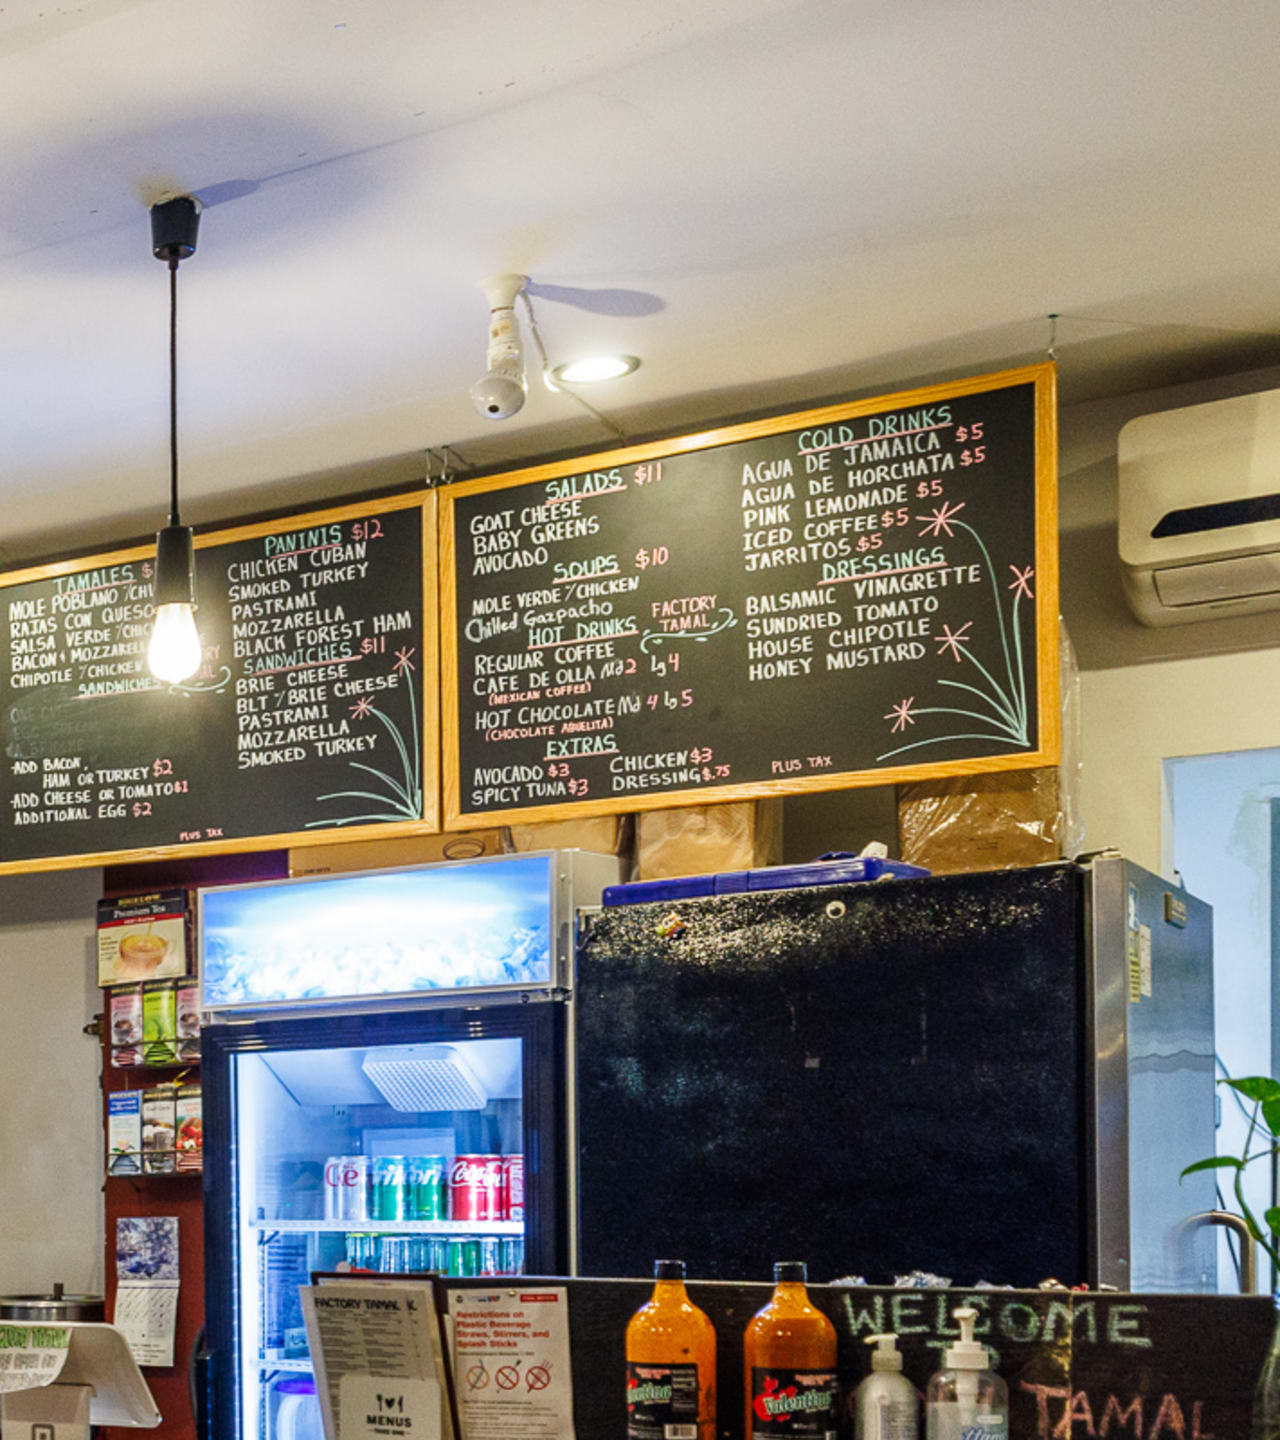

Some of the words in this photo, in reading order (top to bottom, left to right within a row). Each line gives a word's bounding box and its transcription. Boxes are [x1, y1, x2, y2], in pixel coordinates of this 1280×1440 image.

[798, 424, 854, 451] COLD
[868, 405, 953, 437] DRINKS
[742, 457, 794, 487] AGUA
[805, 451, 832, 475] DE
[844, 430, 941, 466] JAMAICA
[955, 422, 984, 442] $5
[546, 468, 623, 500] SALADS
[634, 462, 662, 485] $11
[741, 482, 795, 509] AGUA
[809, 476, 835, 496] DE
[847, 452, 955, 488] HORCHATA
[959, 446, 986, 468] $5
[470, 510, 514, 535] GOAT
[521, 500, 582, 526] CHEESE
[744, 504, 790, 529] PINK
[805, 484, 908, 519] LEMONADE
[916, 479, 943, 499] $5
[264, 524, 341, 556] PANINIS
[351, 519, 384, 541] $12
[473, 530, 522, 556] BABY
[531, 515, 600, 545] GREENS
[743, 527, 793, 552] ICED
[803, 514, 878, 541] COFFEE
[881, 507, 910, 529] $5
[228, 554, 298, 582] CHICKEN
[310, 541, 367, 567] CUBAN
[472, 547, 548, 576] AVOCADO
[553, 555, 619, 581] SOUPS
[635, 546, 669, 569] $10
[744, 538, 851, 572] JARRITOS
[856, 532, 883, 552] $5
[823, 546, 945, 581] DRESSINGS
[53, 565, 135, 594] TAMALES
[228, 579, 290, 602] SMOKED
[300, 562, 369, 589] TURKEY
[746, 587, 836, 617] BALSAMIC
[854, 564, 981, 600] VINAGRETTE
[9, 599, 46, 621] MOLE
[52, 590, 118, 614] POBLANO
[231, 591, 317, 621] PASTRAMI
[472, 595, 512, 616] MOLE
[517, 588, 561, 608] VERDE
[651, 594, 718, 617] FACTORY
[746, 613, 842, 639] SUNDRIED
[854, 595, 939, 624] TOMATO
[10, 619, 57, 638] RAJAS
[64, 613, 92, 630] CON
[102, 603, 155, 624] QUESO
[233, 606, 345, 639] MOZZARELLA
[233, 635, 286, 658] BLACK
[296, 620, 364, 647] FOREST
[374, 610, 412, 633] HAM
[465, 612, 518, 643] Chilled
[523, 599, 614, 627] Gazpacho
[528, 625, 565, 647] HOT
[577, 615, 637, 640] DRINKS
[659, 613, 712, 633] TAMAL
[10, 636, 55, 655] SALSA
[66, 629, 111, 647] VERDE
[244, 642, 352, 674] SANDWICHES
[360, 635, 385, 654] $11
[748, 635, 813, 660] HOUSE
[829, 617, 931, 648] CHIPOTLE
[11, 653, 57, 672] BACON
[475, 651, 544, 676] REGULAR
[555, 641, 615, 665] COFFEE
[749, 657, 813, 681] HONEY
[826, 641, 926, 672] MUSTARD
[10, 668, 73, 689] CHIPOTLE
[235, 676, 274, 696] BRIE
[287, 664, 348, 687] CHEESE
[236, 695, 268, 714] BLT
[334, 674, 399, 698] CHEESE
[473, 675, 519, 696] CAFE
[529, 670, 549, 688] DE
[555, 664, 595, 684] OLLA
[239, 705, 329, 731] PASTRAMI
[475, 709, 512, 731] HOT
[518, 698, 616, 725] CHOCOLATE
[237, 747, 306, 770] SMOKED
[314, 734, 378, 758] TURKEY
[238, 720, 350, 750] MOZZARELLA
[546, 734, 617, 758] EXTRAS
[43, 773, 70, 789] HAM
[95, 766, 150, 784] TURKEY
[152, 758, 173, 778] $2
[474, 764, 544, 787] AVOCADO
[547, 763, 570, 778] $3
[610, 750, 689, 774] CHICKEN
[689, 747, 713, 765] $3
[44, 789, 91, 806] CHEESE
[118, 782, 173, 800] TOMATO
[173, 781, 189, 793] $1
[471, 786, 522, 806] SPICY
[527, 781, 566, 797] TUNA
[567, 778, 590, 797] $3
[612, 767, 702, 792] DRESSING
[14, 809, 91, 825] ADDITIONAL
[98, 804, 127, 819] EGG
[133, 802, 152, 818] $2
[842, 1293, 1153, 1348] WELCOME
[367, 1415, 412, 1428] MENUS
